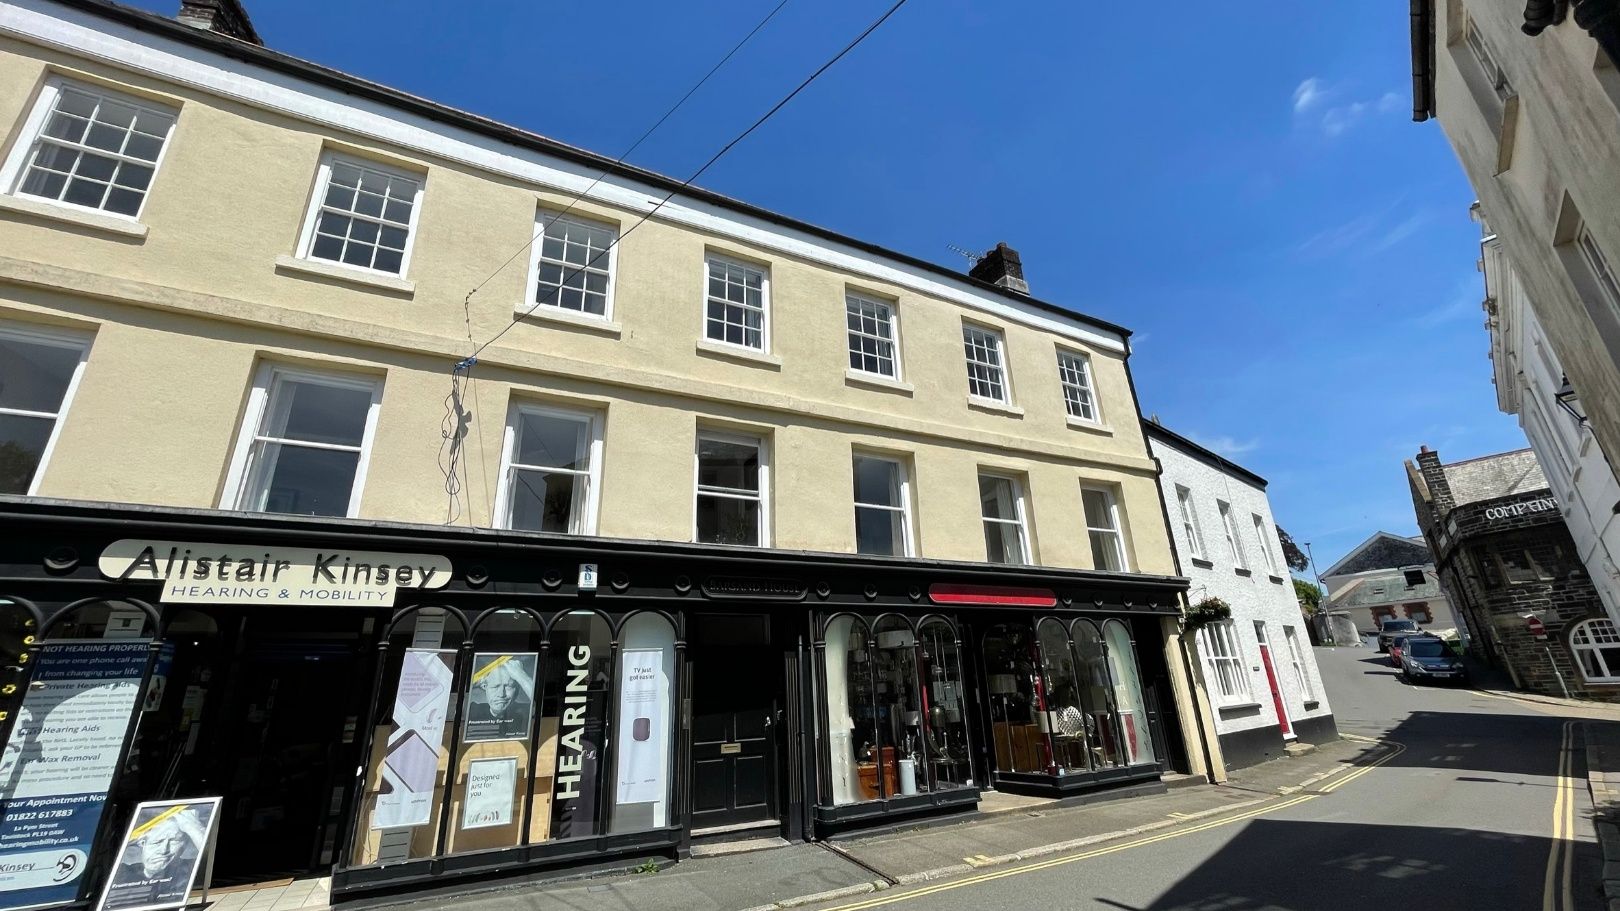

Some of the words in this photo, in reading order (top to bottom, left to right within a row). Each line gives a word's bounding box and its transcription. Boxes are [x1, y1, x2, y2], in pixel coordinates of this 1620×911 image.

[117, 545, 291, 583] Alistair
[312, 553, 436, 590] Kinsey
[171, 586, 269, 598] HEARING
[278, 588, 290, 599] &
[300, 589, 388, 601] MOBILITY
[43, 645, 63, 653] NOT
[65, 644, 108, 652] HEARING
[89, 656, 116, 665] phone
[45, 669, 65, 677] from
[66, 668, 104, 677] changing
[104, 669, 124, 677] your
[77, 682, 110, 690] Hearing
[556, 645, 591, 800] HEARING
[43, 726, 80, 734] Hearing
[61, 753, 101, 763] Removal
[26, 795, 88, 807] Appointment
[6, 812, 36, 822] 01822
[38, 809, 74, 819] 617883
